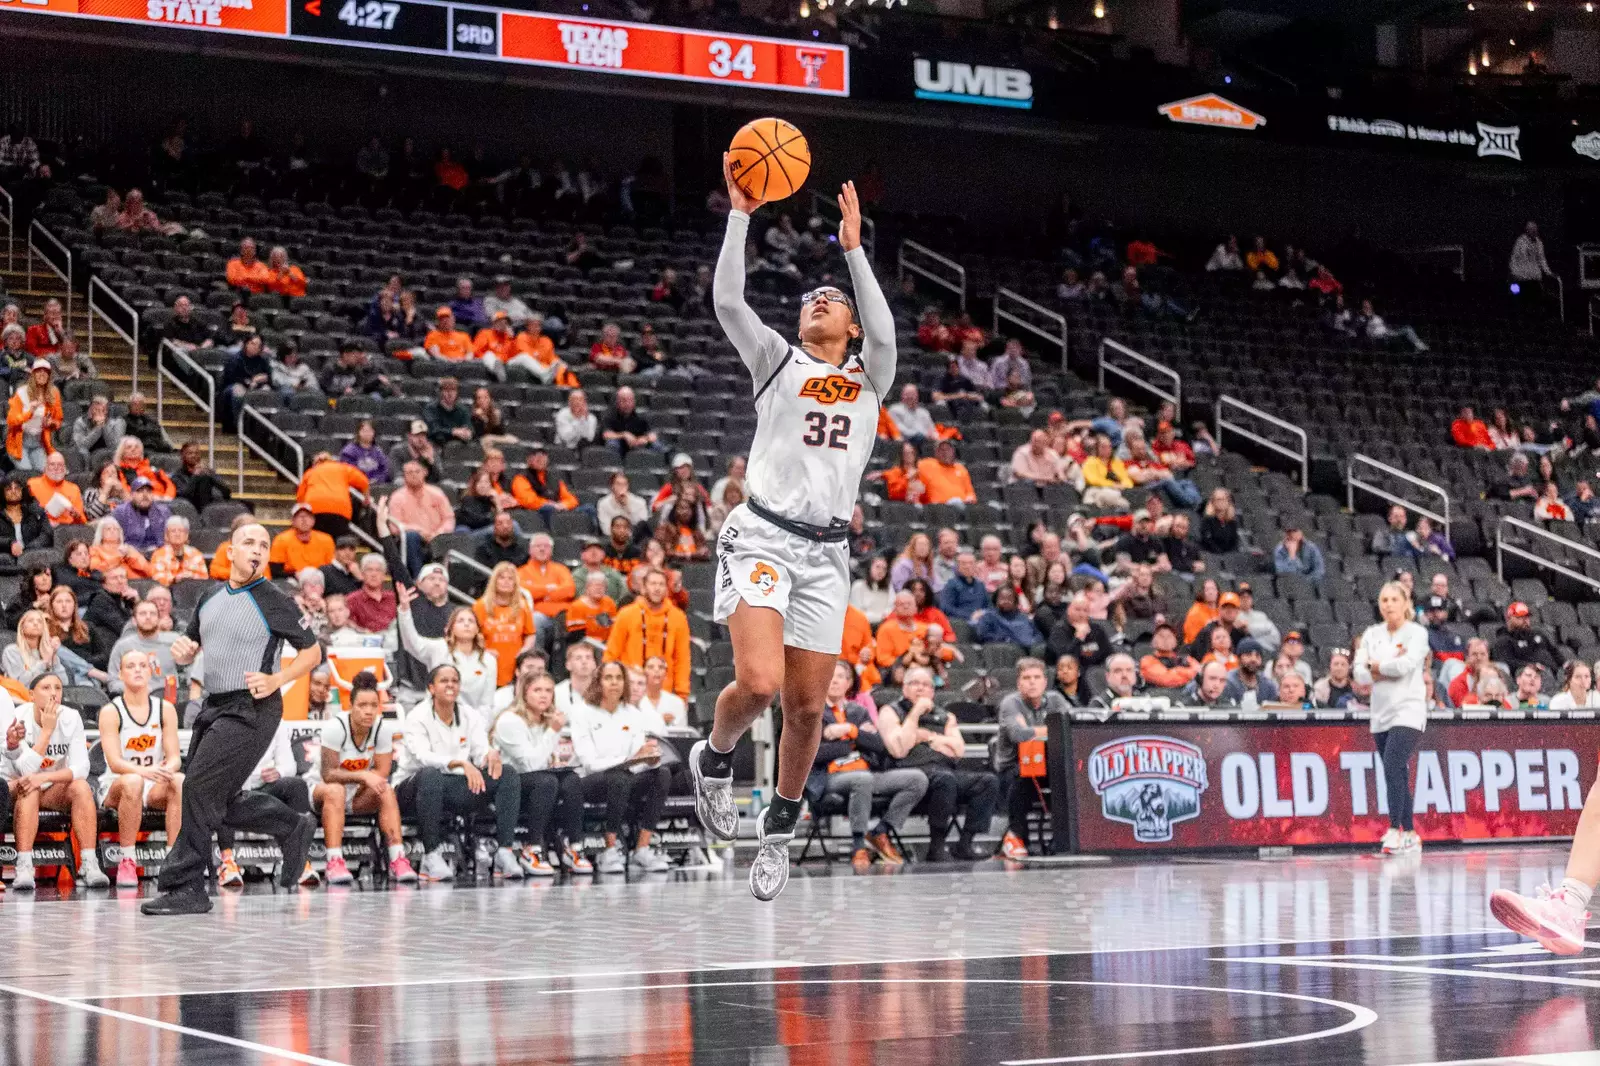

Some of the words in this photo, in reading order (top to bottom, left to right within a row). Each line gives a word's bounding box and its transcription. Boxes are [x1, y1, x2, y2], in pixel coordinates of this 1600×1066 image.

[147, 1, 222, 25] STATE
[338, 0, 400, 30] 4:27
[456, 23, 495, 46] 3RD
[558, 23, 628, 50] TEXAS
[565, 45, 624, 68] TECH
[708, 40, 756, 79] 34
[913, 58, 1033, 101] UMB
[798, 374, 863, 406] OSU
[803, 410, 852, 452] 32
[1091, 751, 1125, 784] OLD
[1124, 742, 1203, 782] TRAPPER
[1220, 751, 1329, 819] OLD
[236, 846, 283, 858] Allstate
